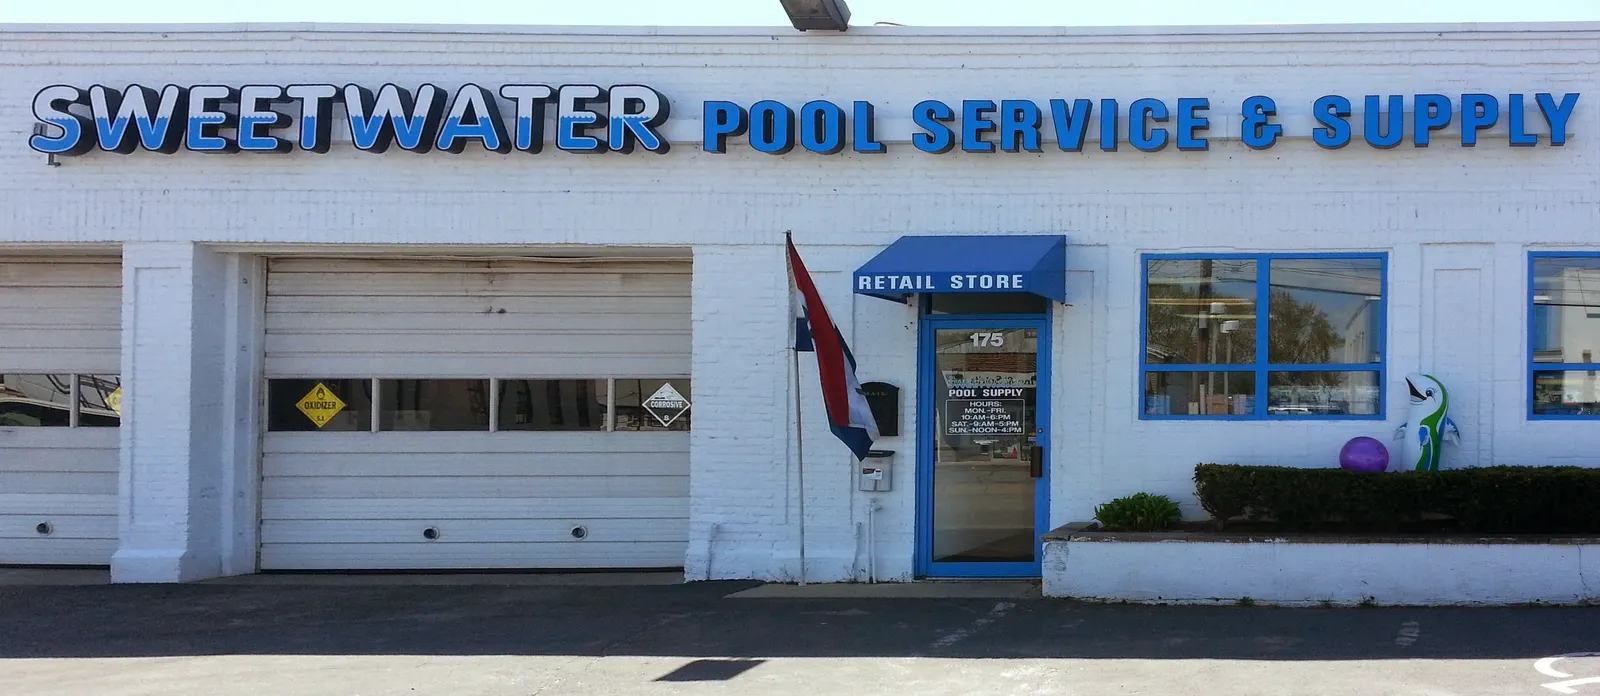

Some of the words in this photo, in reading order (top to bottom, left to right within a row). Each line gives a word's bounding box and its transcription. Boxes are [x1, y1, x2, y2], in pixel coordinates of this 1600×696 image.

[30, 83, 670, 154] SWEETWATER
[703, 100, 886, 154] POOL
[912, 97, 1210, 153] SERVICE
[1241, 95, 1283, 150] &
[1312, 92, 1581, 149] SUPPLY
[858, 275, 935, 290] RETAIL
[950, 274, 1023, 289] STORE
[970, 332, 1004, 347] 175
[948, 389, 977, 397] POOL
[982, 388, 1023, 397] SUPPLY
[304, 401, 337, 410] OXIDIZER
